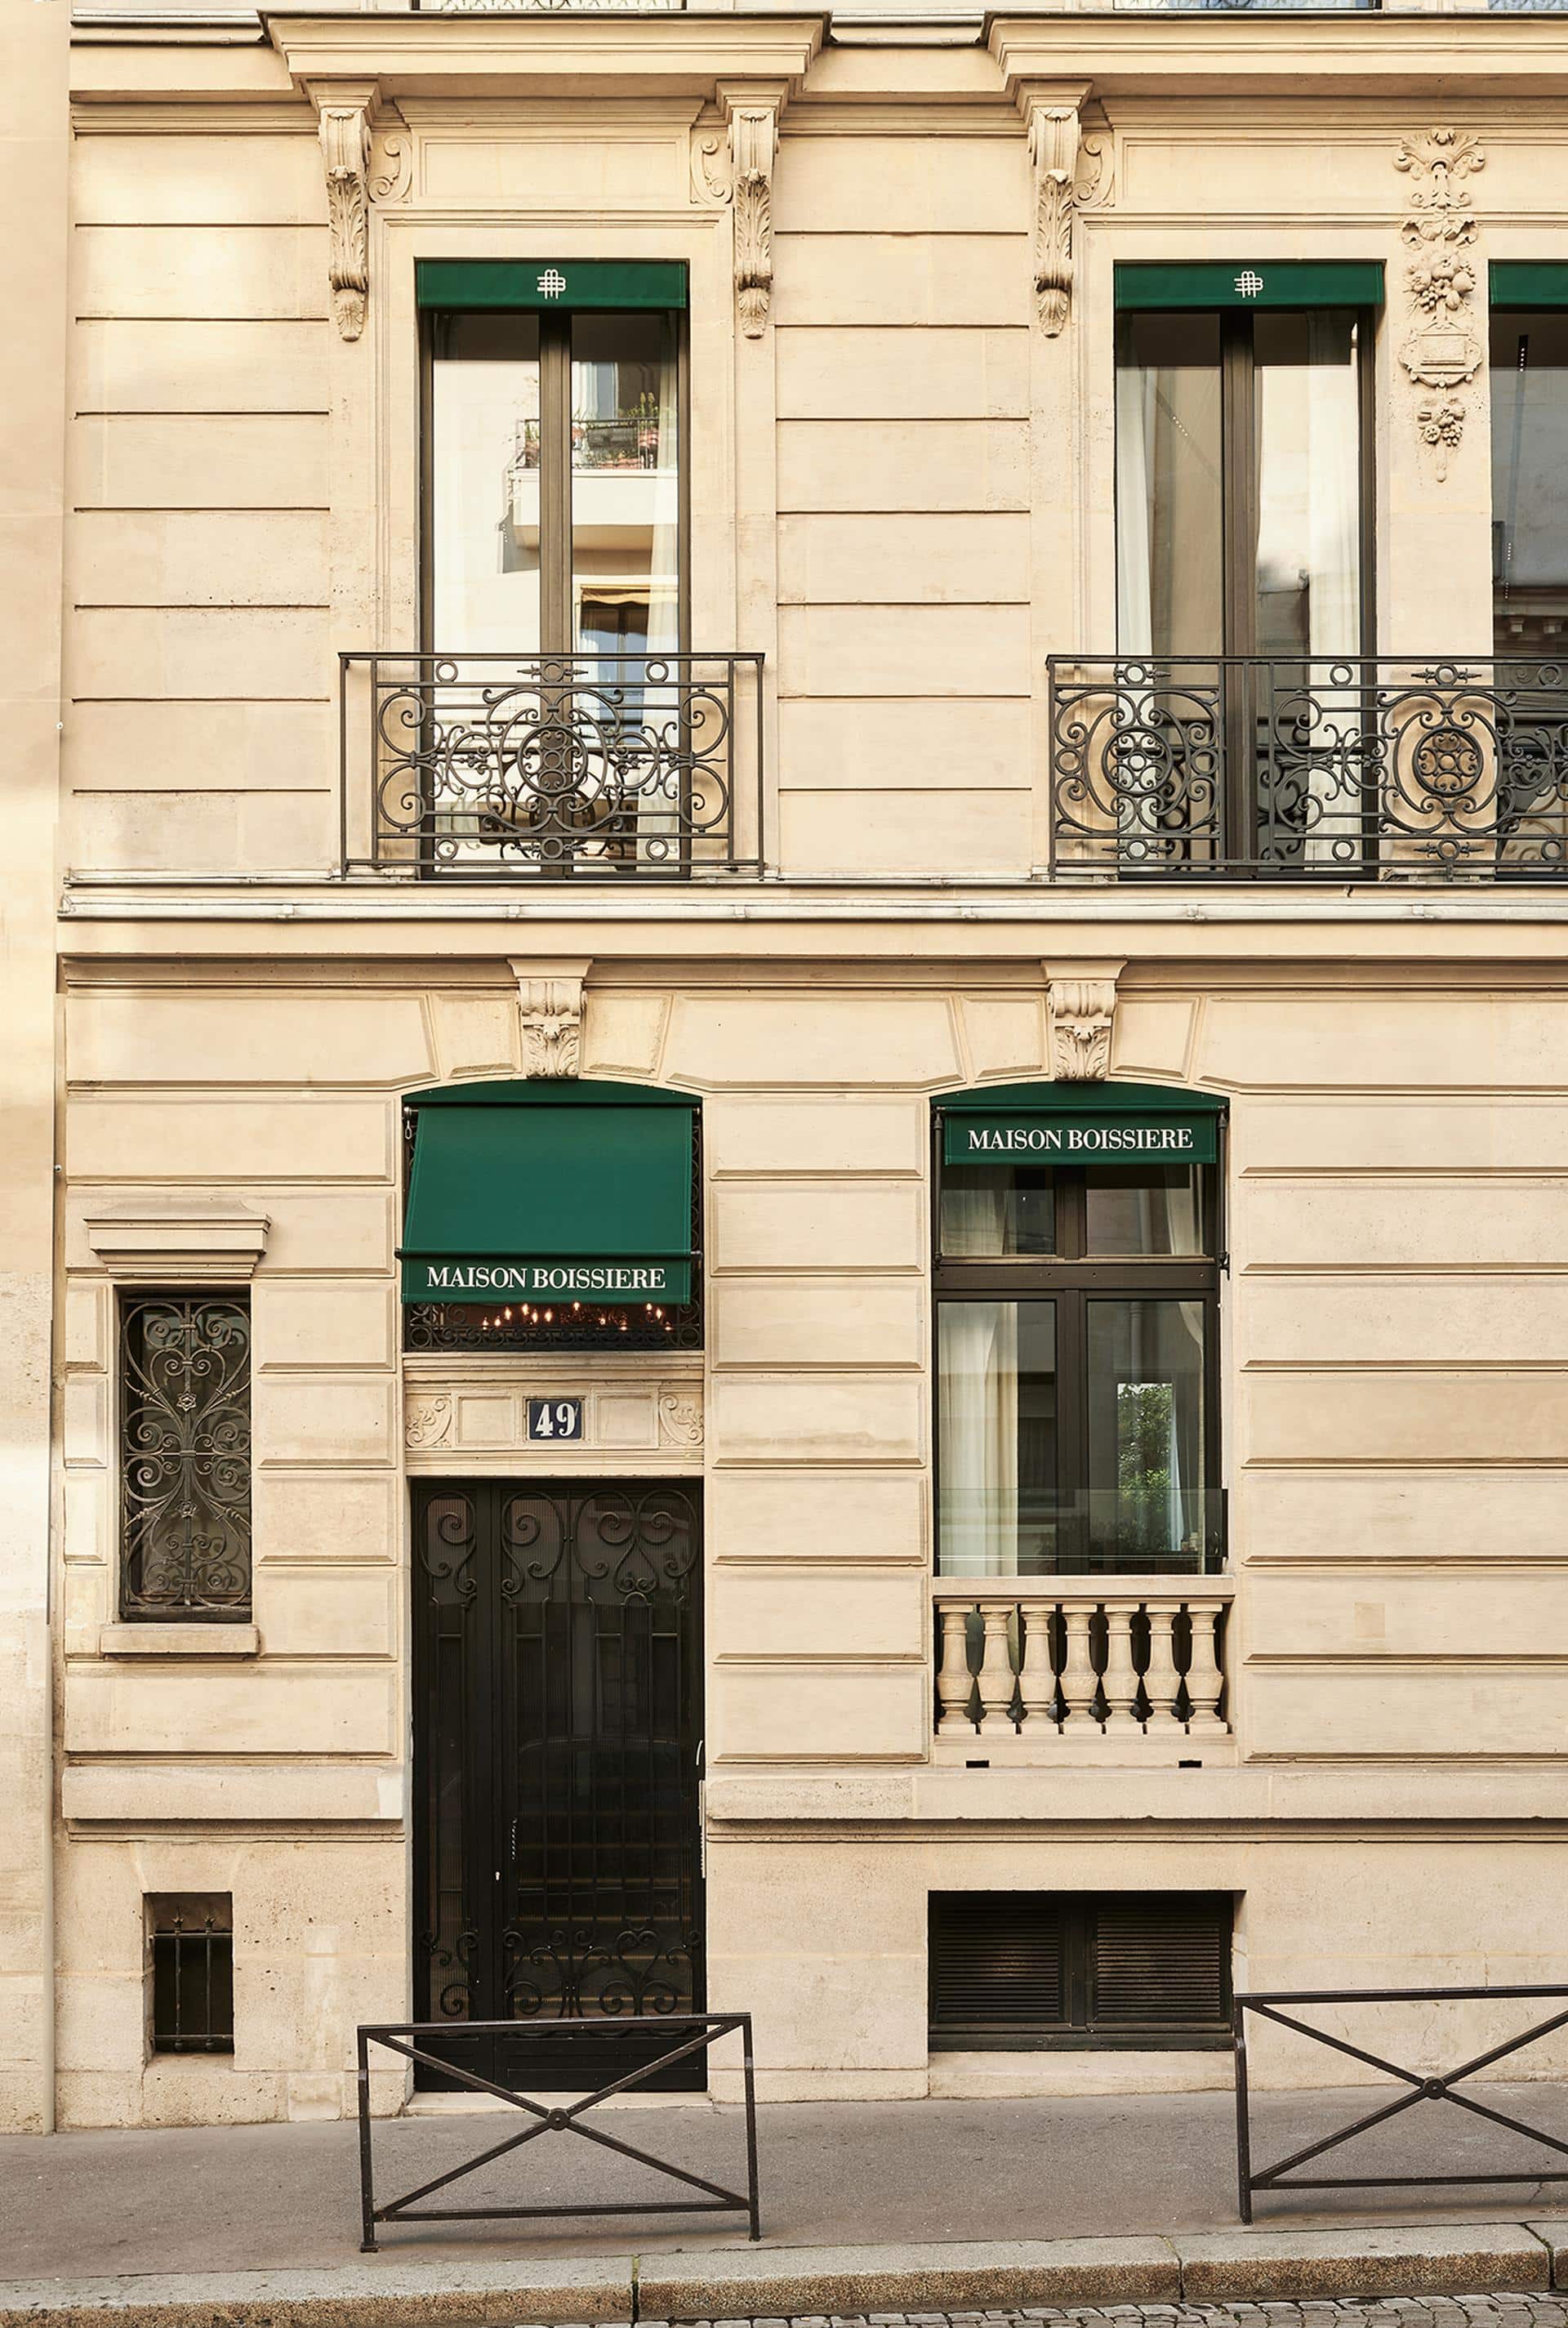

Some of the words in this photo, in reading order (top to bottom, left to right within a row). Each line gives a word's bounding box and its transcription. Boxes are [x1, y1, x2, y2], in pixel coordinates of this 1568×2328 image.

[968, 1129, 1062, 1150] MAISON
[1067, 1128, 1193, 1149] BOISSIERE
[426, 1266, 527, 1288] MAISON
[532, 1268, 666, 1289] BOISSIERE
[535, 1403, 577, 1437] 49
